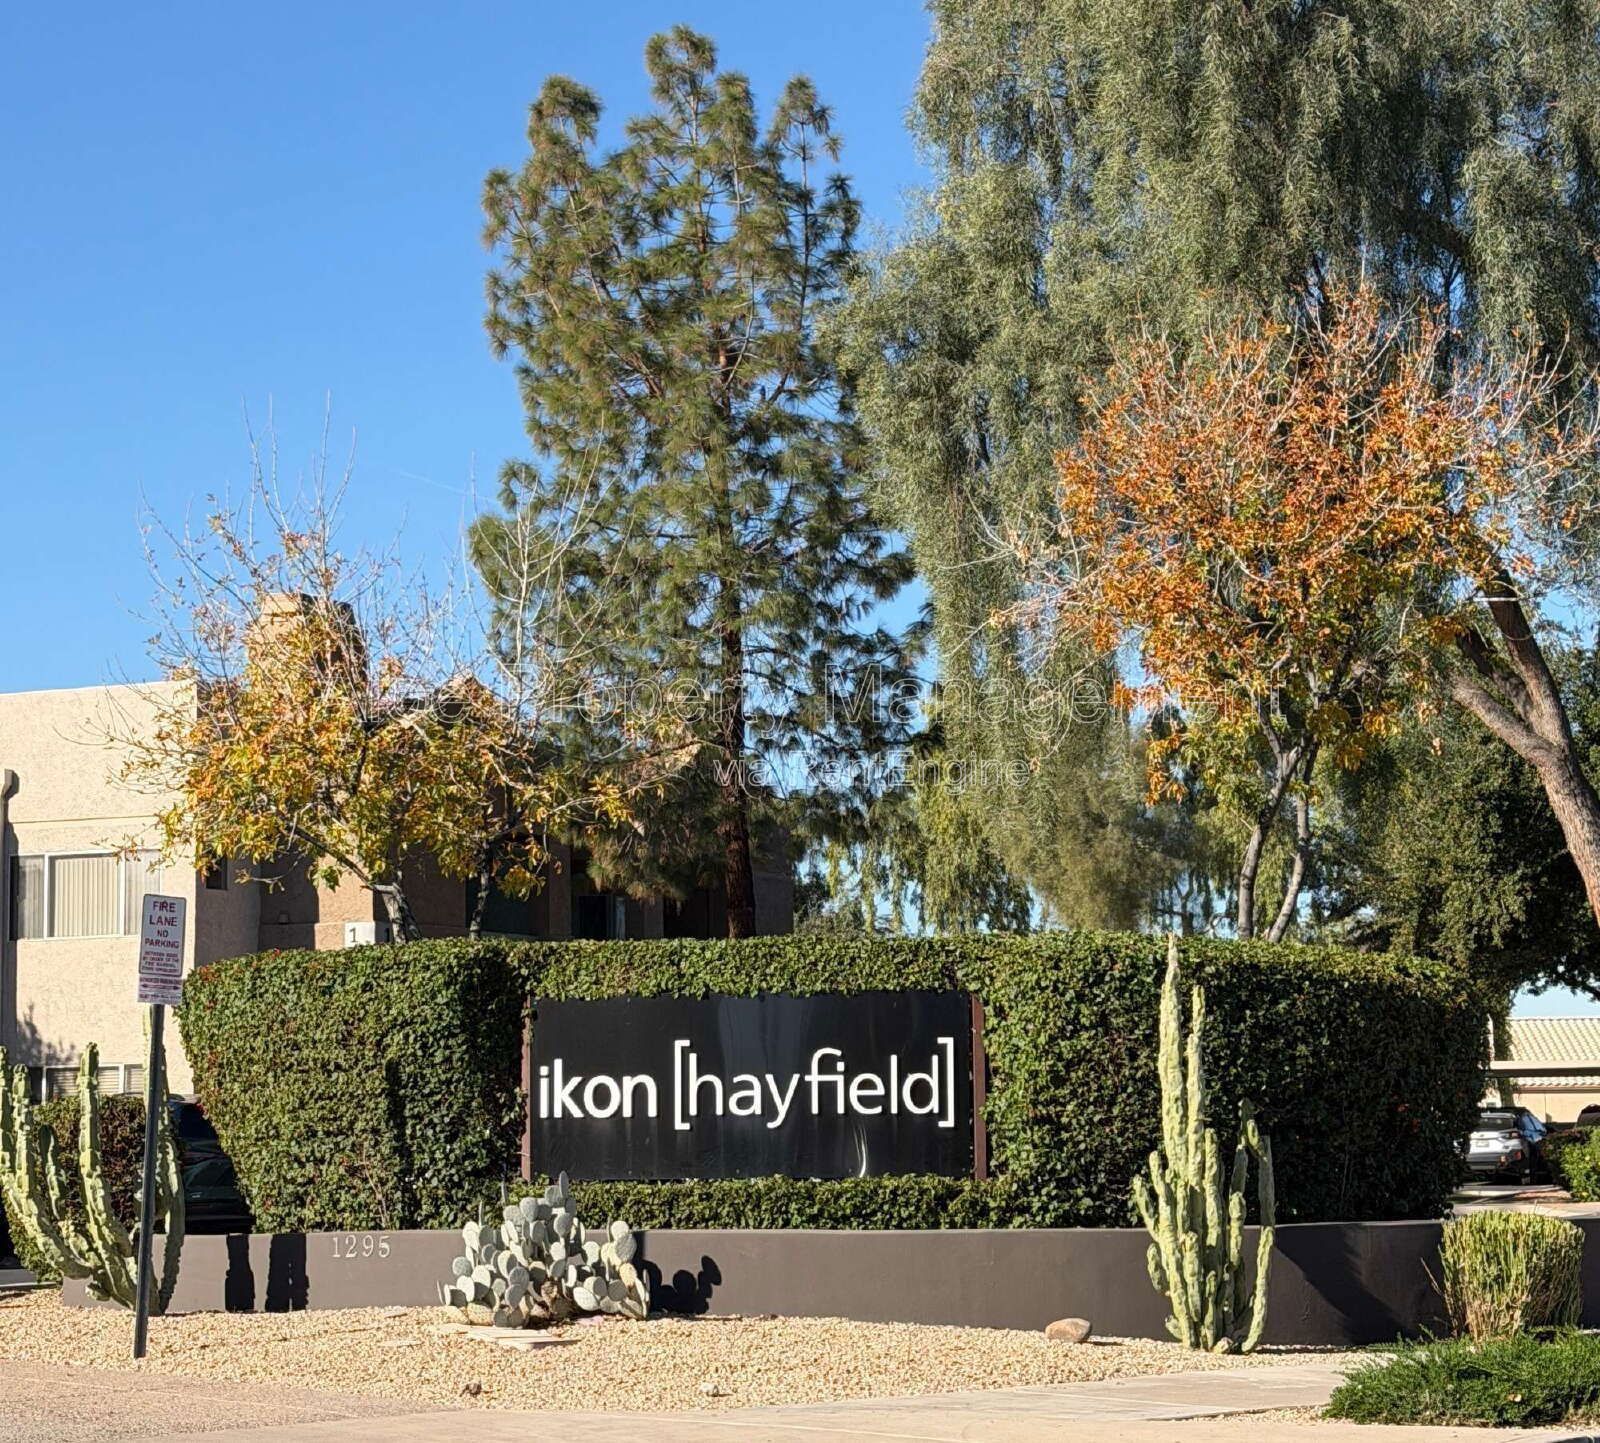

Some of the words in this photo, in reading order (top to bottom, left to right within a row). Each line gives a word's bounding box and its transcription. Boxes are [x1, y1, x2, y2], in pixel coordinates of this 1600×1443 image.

[152, 900, 176, 912] FIRE
[148, 914, 177, 927] LANE
[157, 929, 169, 938] NO
[144, 937, 179, 949] PARKING
[538, 1058, 659, 1120] ikon
[332, 1234, 392, 1258] 1295
